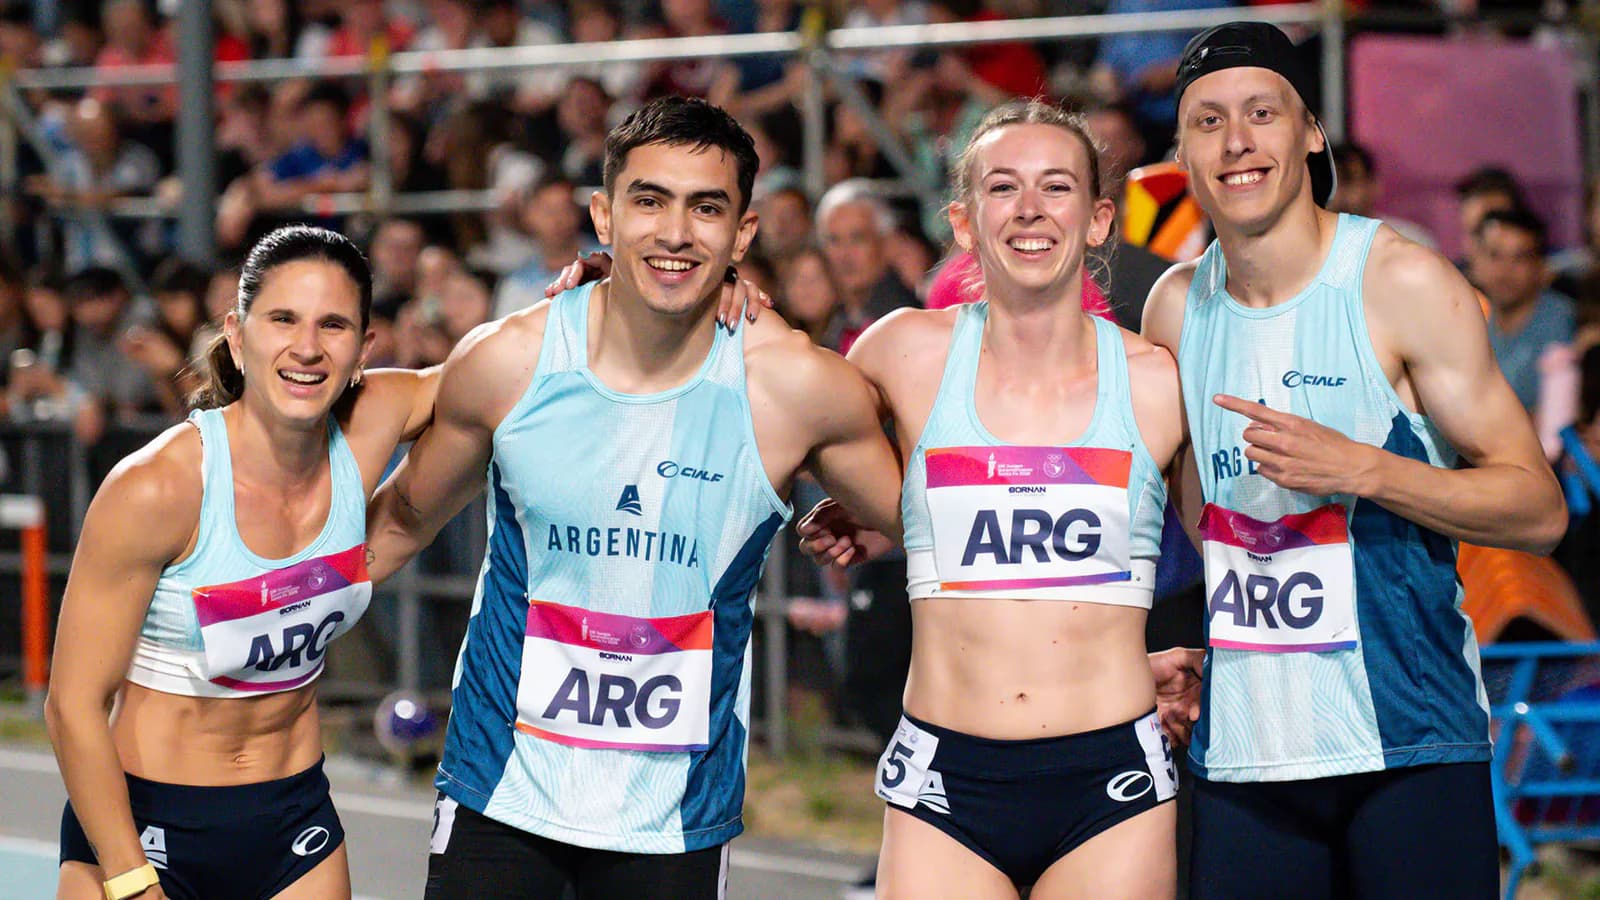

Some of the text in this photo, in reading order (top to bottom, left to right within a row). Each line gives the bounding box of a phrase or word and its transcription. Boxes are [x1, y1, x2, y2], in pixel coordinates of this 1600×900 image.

[1302, 375, 1348, 387] CIALF
[680, 466, 725, 483] CIALF
[547, 523, 699, 569] ARGENTINA
[960, 507, 1102, 567] ARG
[1208, 568, 1324, 630] ARG
[242, 610, 345, 672] ARG
[541, 666, 683, 730] ARG
[881, 740, 915, 789] 5
